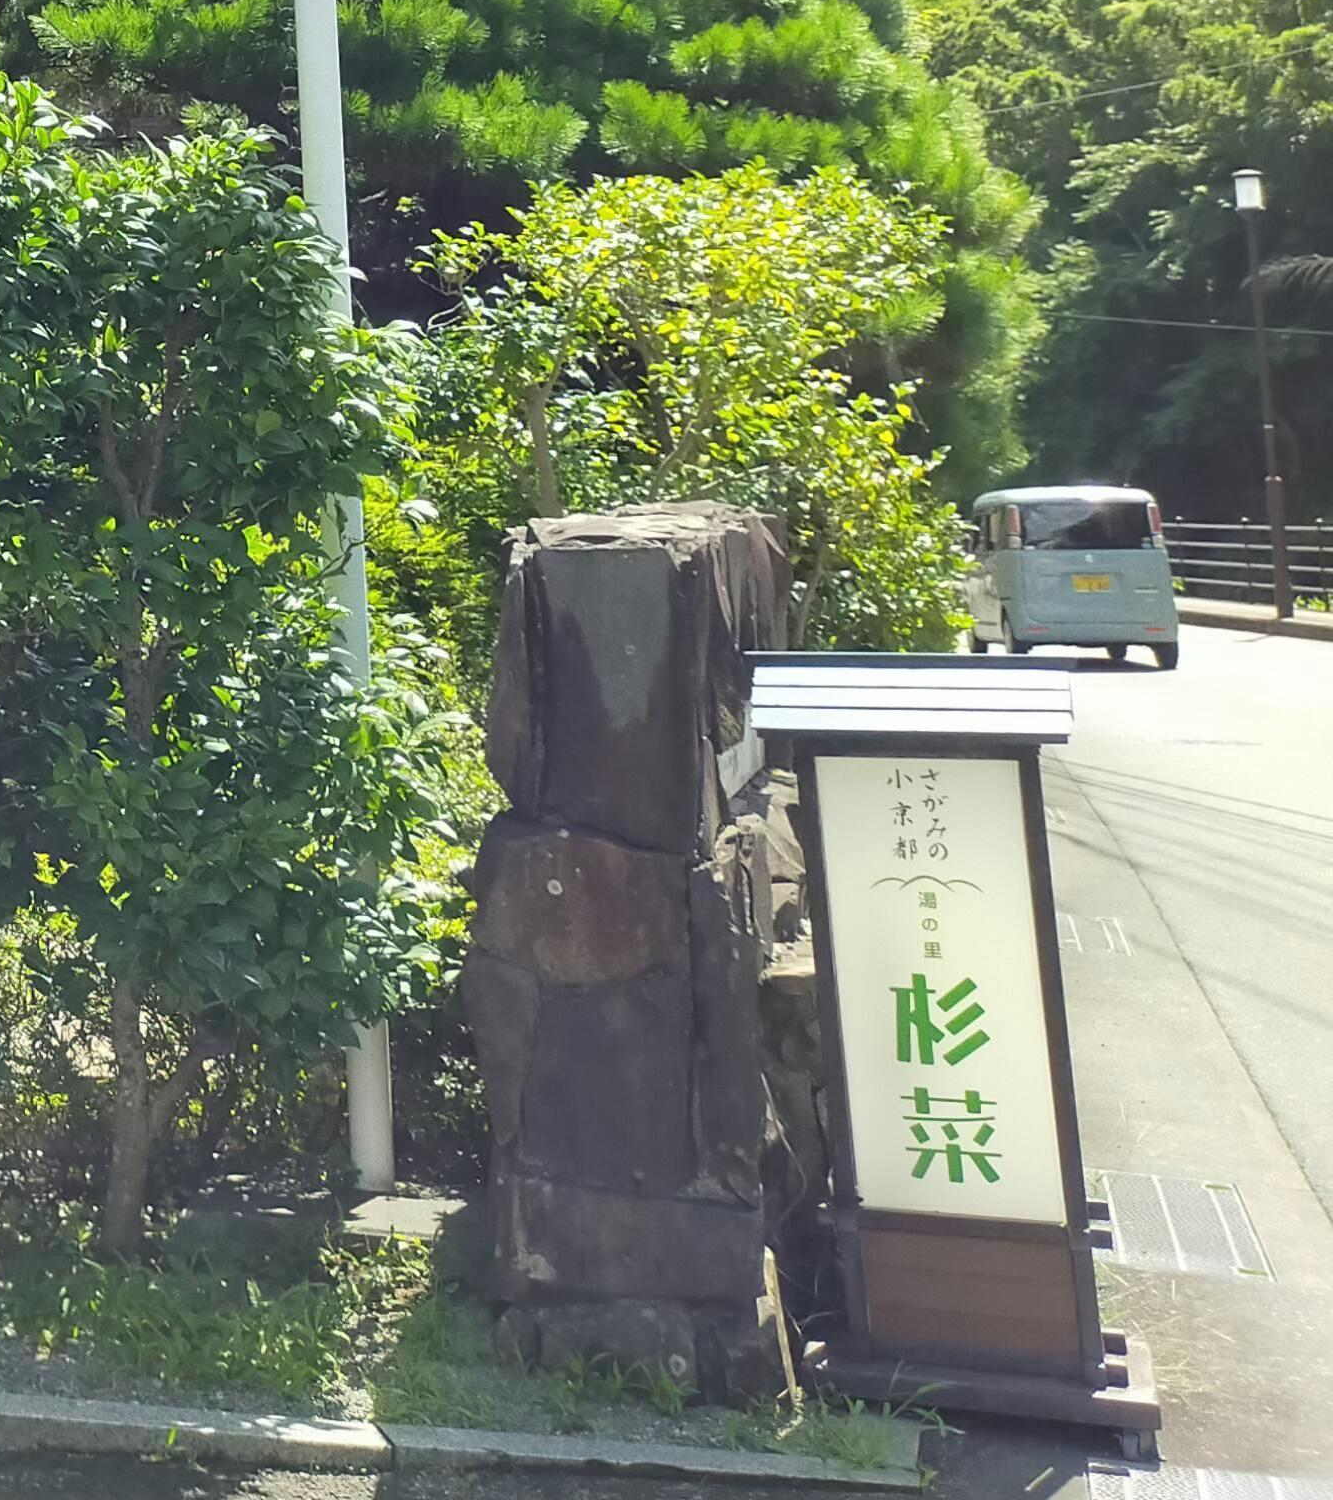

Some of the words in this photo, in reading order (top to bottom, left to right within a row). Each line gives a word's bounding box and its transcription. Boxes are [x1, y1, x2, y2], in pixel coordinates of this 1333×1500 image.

[886, 768, 918, 861] 小京都
[919, 768, 949, 861] さがみの
[888, 972, 1003, 1185] 杉菜
